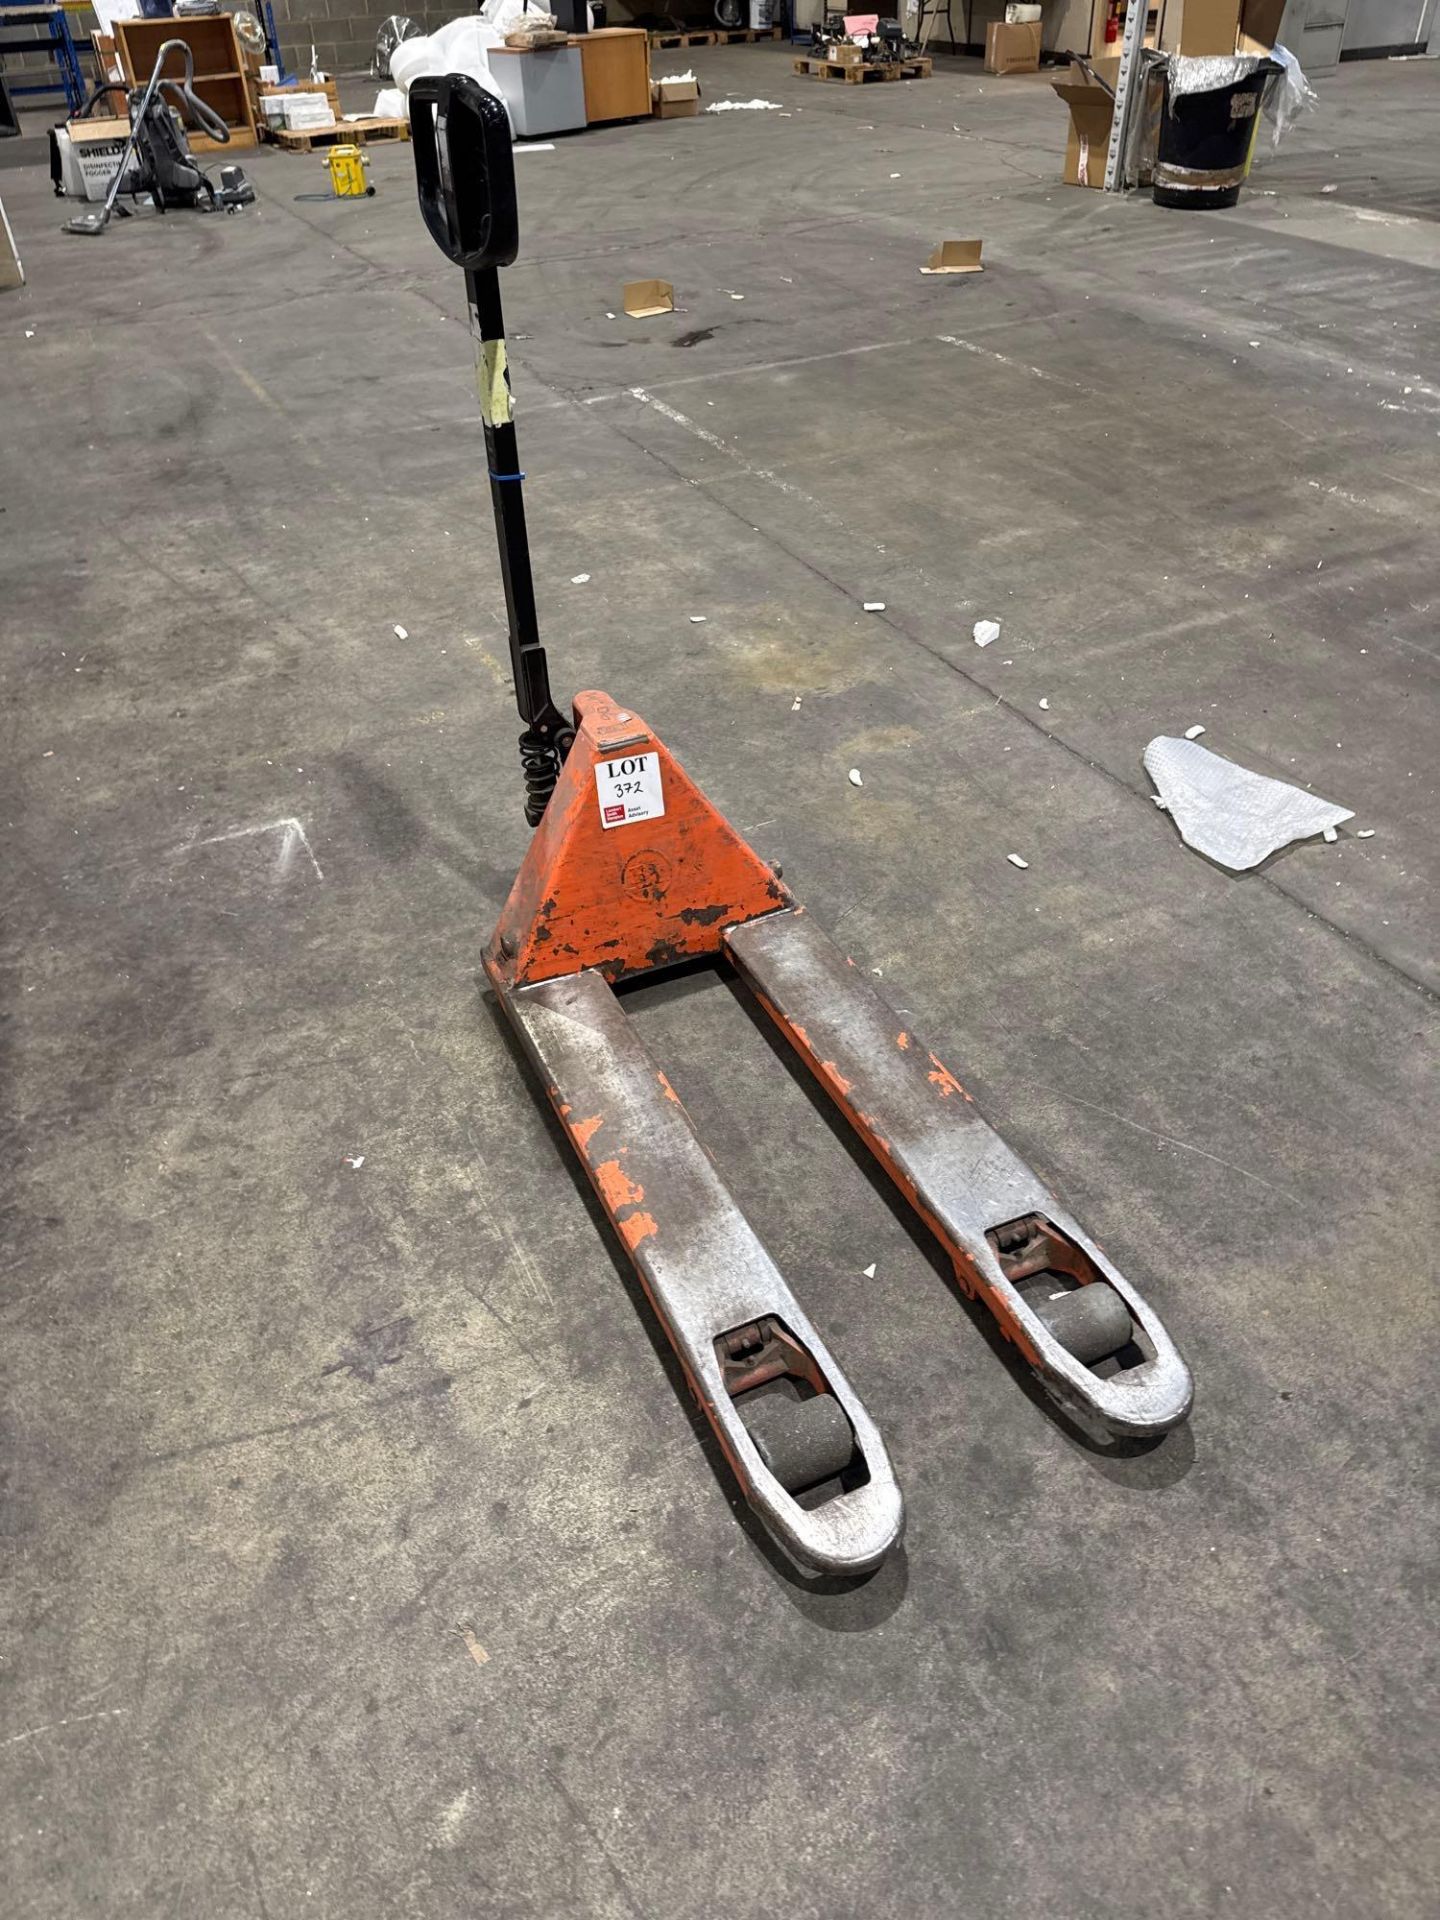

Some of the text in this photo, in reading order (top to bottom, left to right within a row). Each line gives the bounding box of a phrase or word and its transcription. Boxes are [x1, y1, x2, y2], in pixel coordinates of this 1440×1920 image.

[80, 147, 121, 158] SHIELD
[607, 756, 648, 778] LOT
[614, 781, 644, 798] 372
